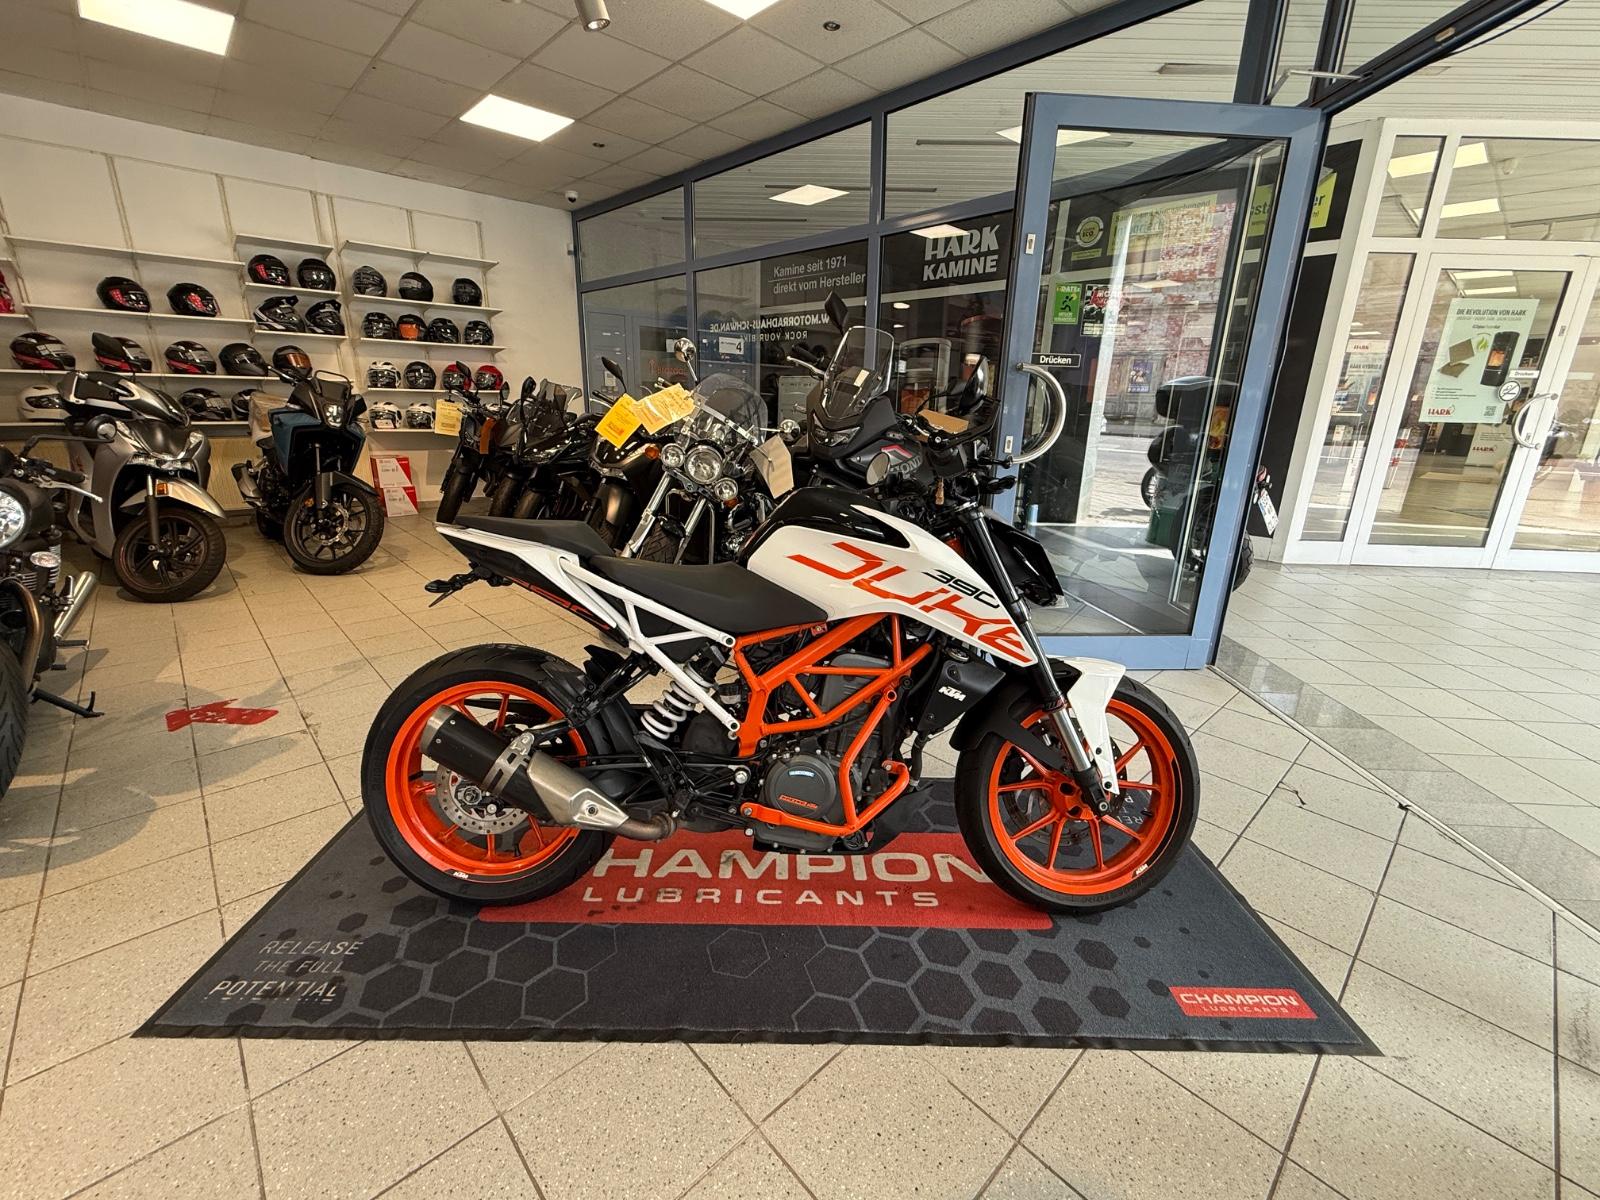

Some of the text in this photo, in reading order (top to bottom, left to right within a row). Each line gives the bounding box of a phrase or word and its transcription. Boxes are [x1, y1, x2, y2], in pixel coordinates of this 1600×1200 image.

[925, 225, 1000, 260] HARK
[773, 255, 847, 278] Kamine seit 1971
[923, 254, 999, 281] KAMINE
[773, 272, 867, 294] direkt vom Hersteller
[1040, 355, 1072, 365] Drücken
[921, 568, 1001, 609] 390
[786, 541, 1033, 663] DUKE
[938, 685, 967, 702] KTM
[593, 848, 993, 884] HAMPION
[582, 886, 940, 908] LUBRICANTS
[258, 940, 364, 955] RELEASE
[254, 960, 345, 973] THE FULL
[208, 980, 338, 997] POTENTIAL
[1180, 993, 1300, 1006] CHAMPION
